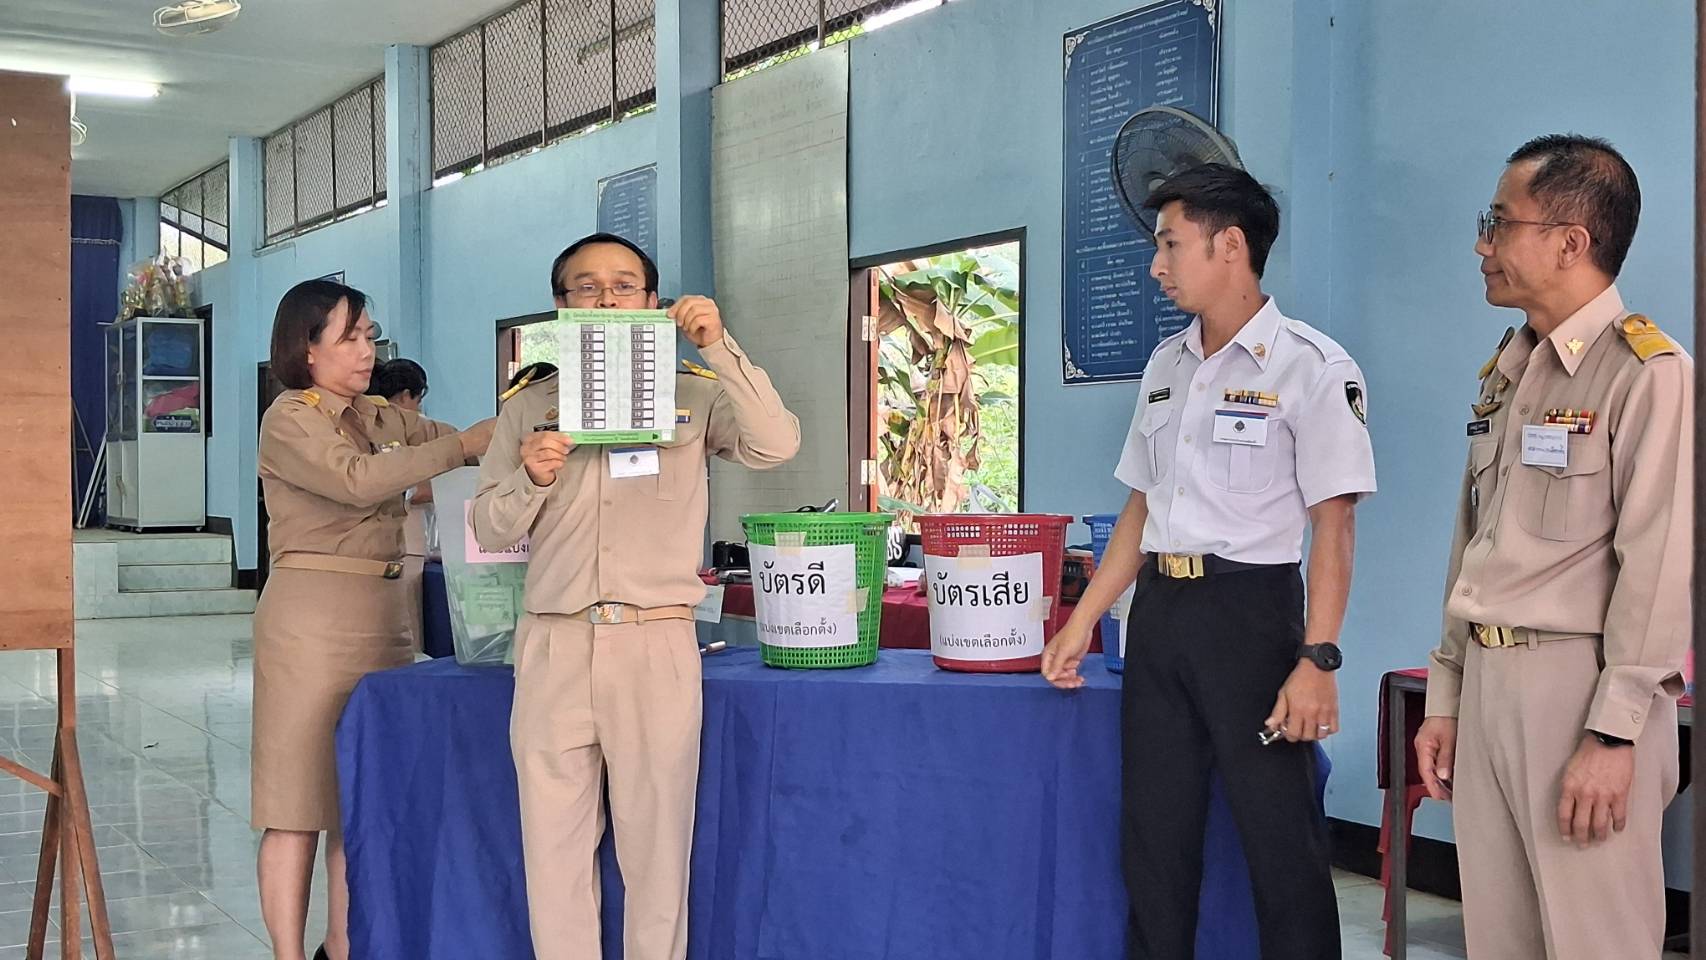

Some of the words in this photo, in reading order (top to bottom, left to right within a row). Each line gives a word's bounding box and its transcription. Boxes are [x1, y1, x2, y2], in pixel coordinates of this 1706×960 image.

[759, 560, 825, 595] บัตรดี
[932, 571, 1029, 607] บัตรเสีย
[939, 628, 1027, 647] (แบ่งเขตเลือกตั้ง)
